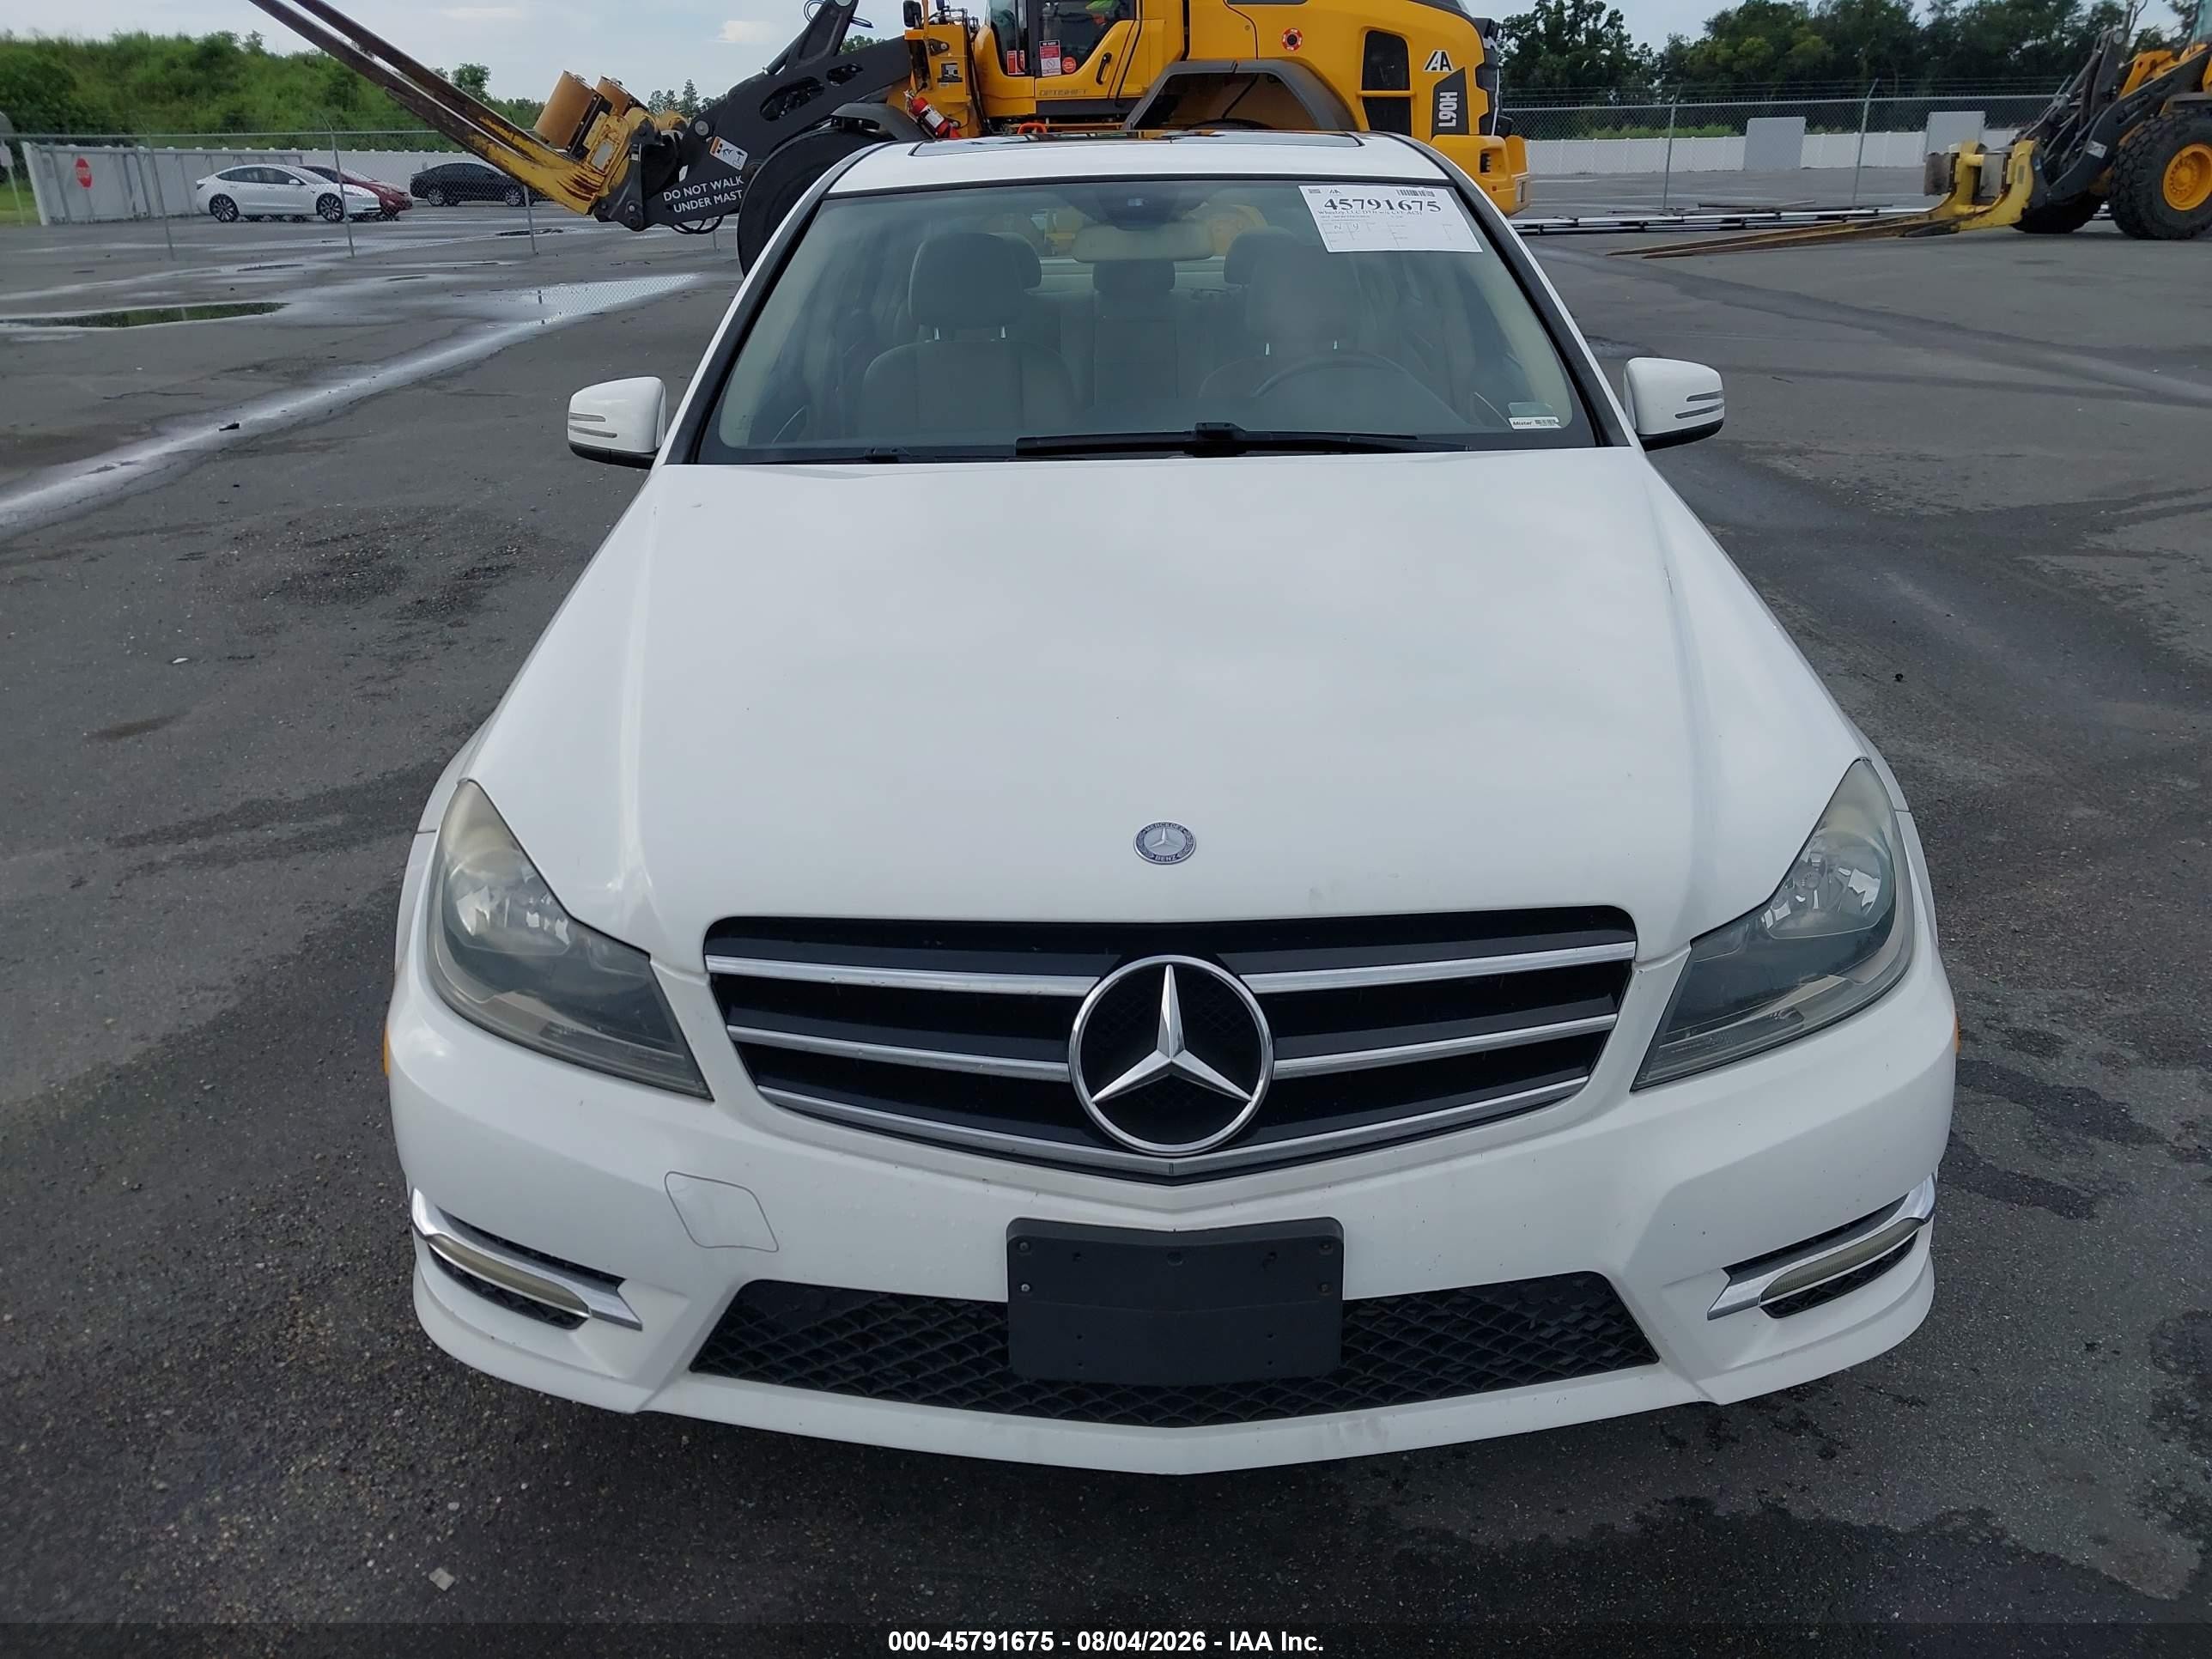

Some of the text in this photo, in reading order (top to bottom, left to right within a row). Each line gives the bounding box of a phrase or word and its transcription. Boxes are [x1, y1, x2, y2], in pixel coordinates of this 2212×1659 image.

[1437, 91, 1458, 127] L90H
[663, 175, 744, 202] DO NOT WALK
[672, 189, 743, 213] UNDER MAST
[1323, 198, 1442, 213] 45791675
